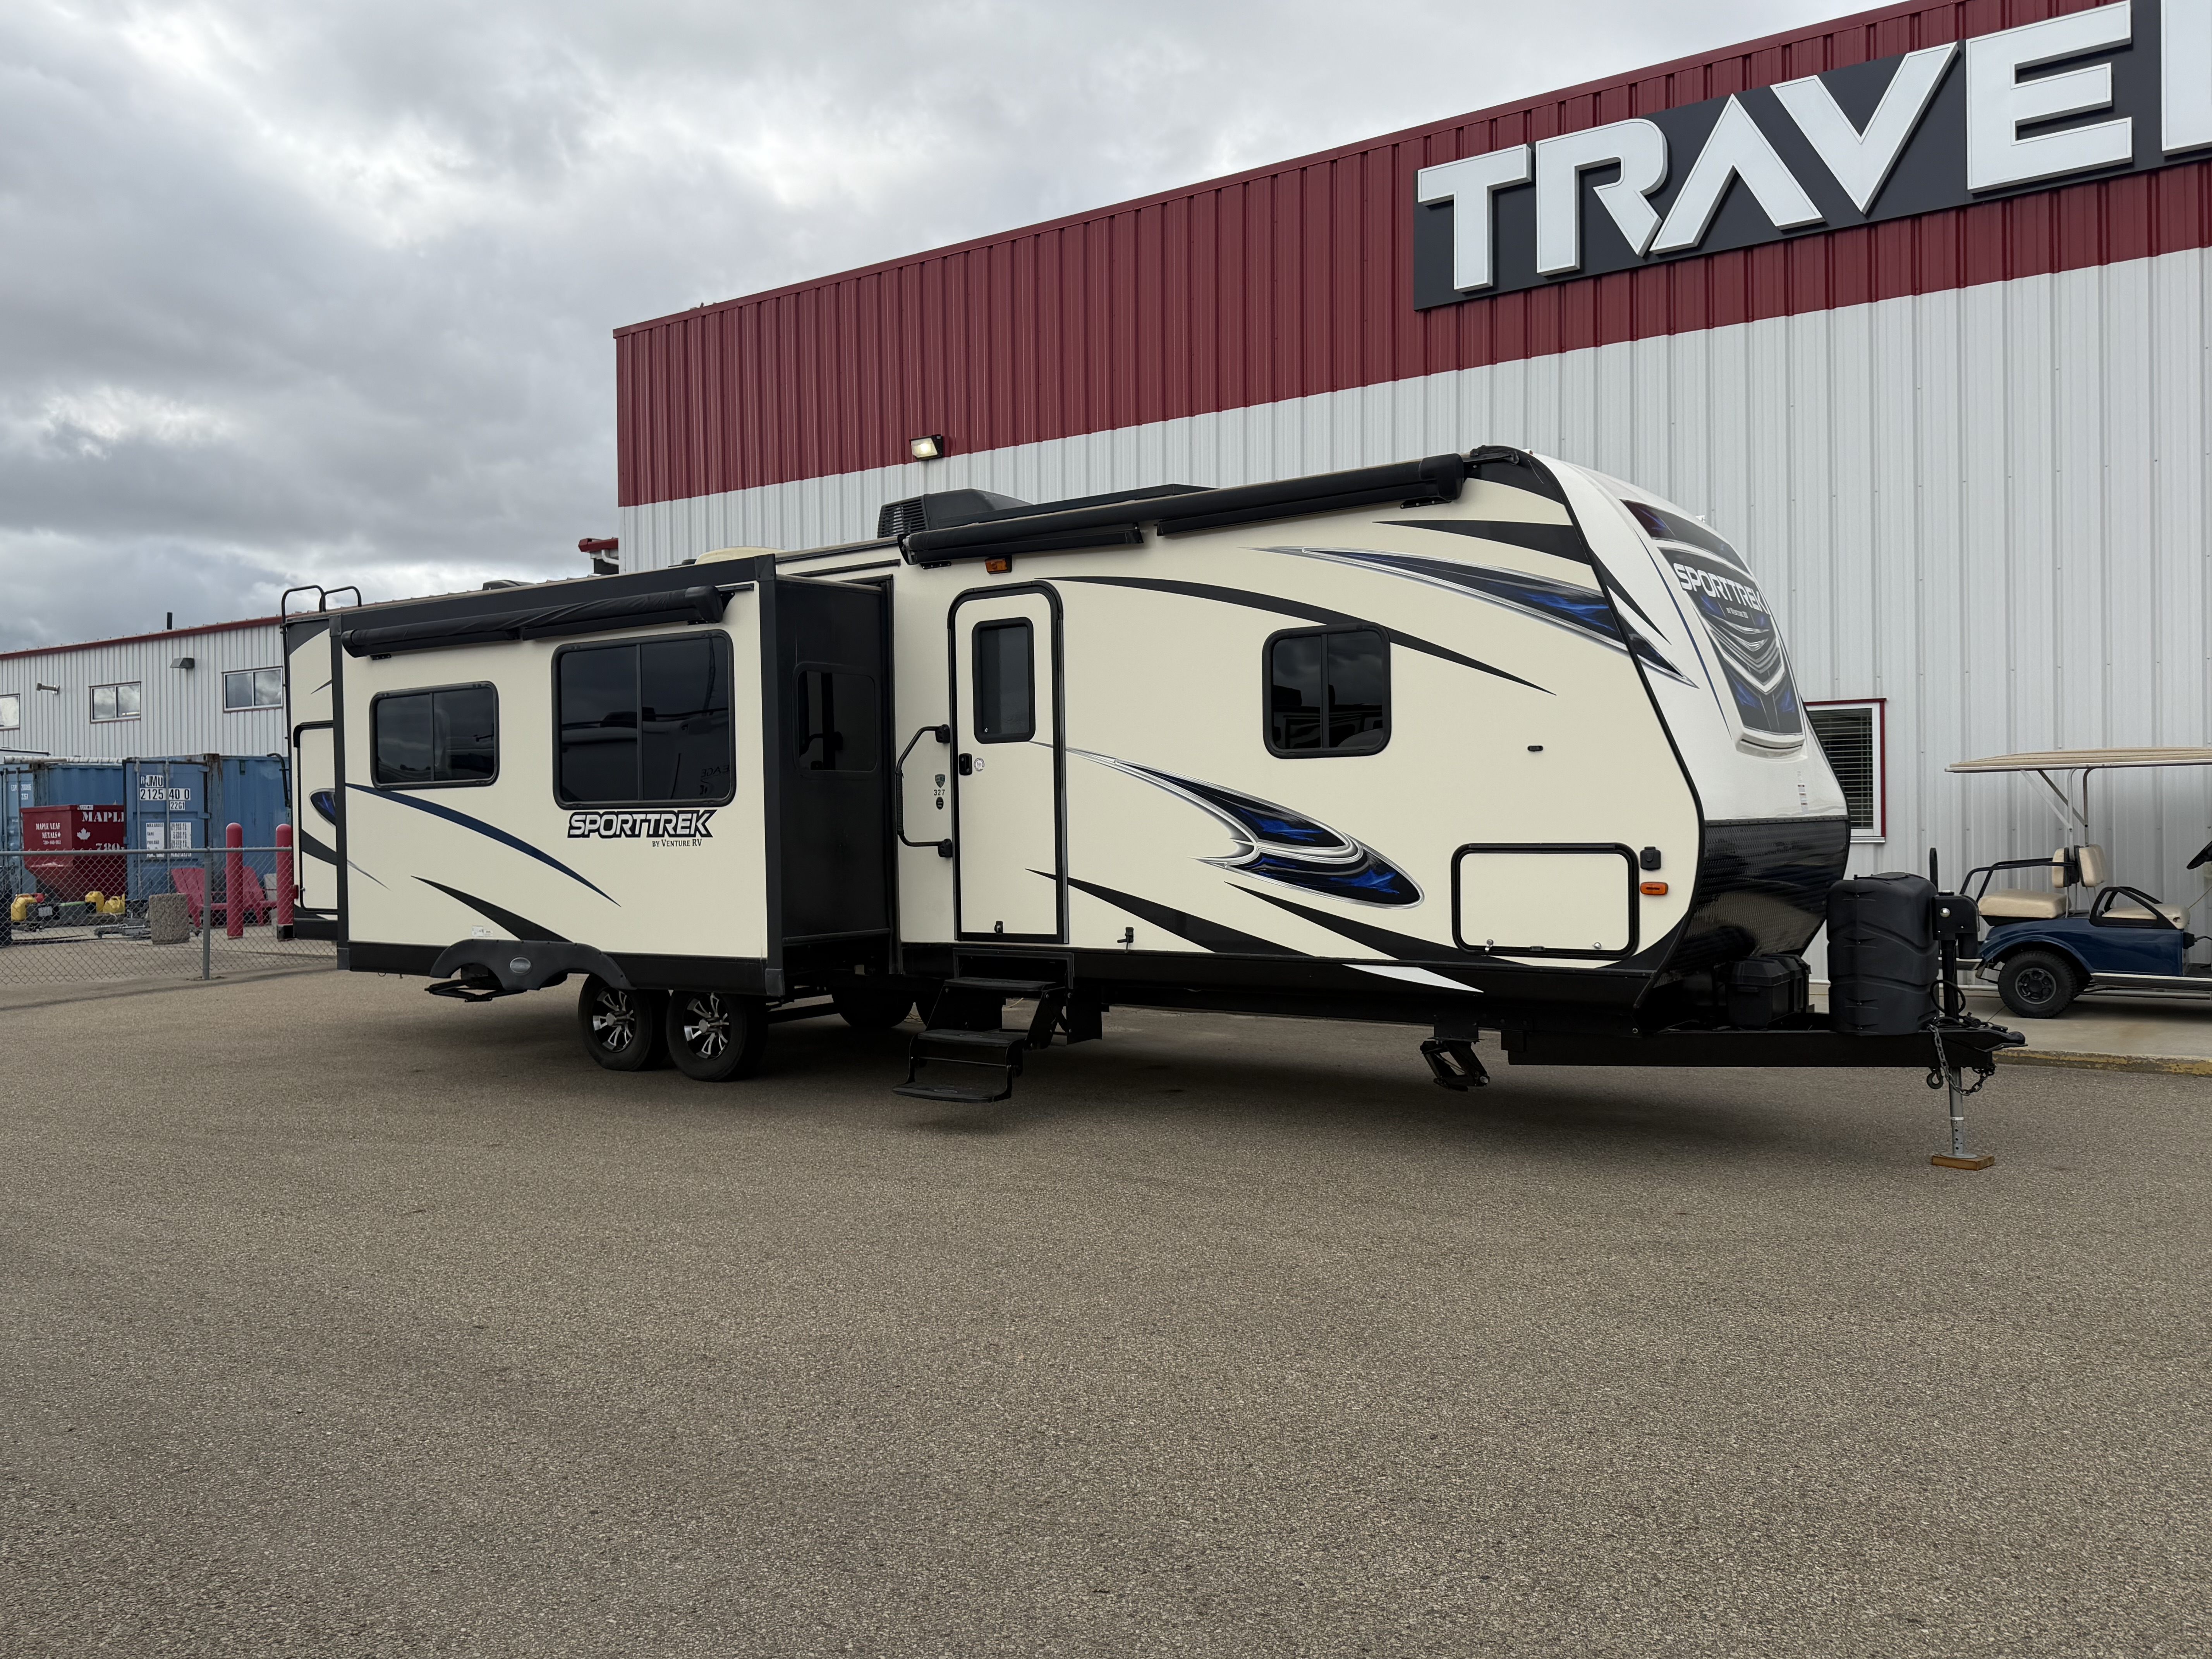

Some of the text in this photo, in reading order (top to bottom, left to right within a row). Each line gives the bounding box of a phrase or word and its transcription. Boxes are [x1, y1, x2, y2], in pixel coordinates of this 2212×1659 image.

[1673, 563, 1769, 614] SPORTTREK
[568, 810, 715, 838] SPORTTREK
[661, 839, 690, 847] VENTURE
[692, 838, 702, 847] RV
